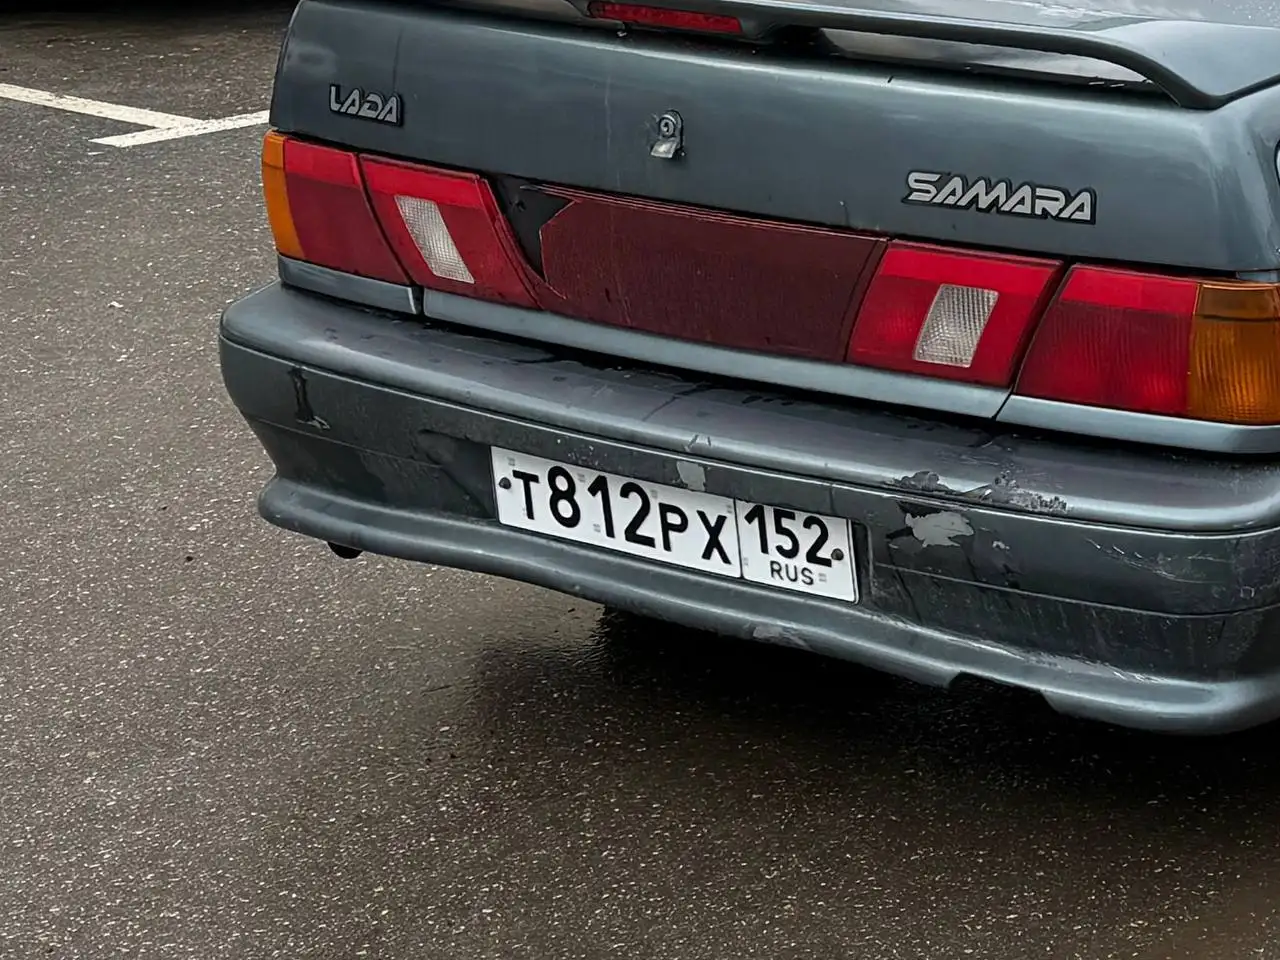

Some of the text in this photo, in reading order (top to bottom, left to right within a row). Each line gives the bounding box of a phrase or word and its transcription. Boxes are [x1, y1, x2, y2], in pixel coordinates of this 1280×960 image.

[329, 84, 400, 124] LADA
[907, 171, 1092, 221] SAMARA
[743, 504, 833, 568] 152
[769, 560, 815, 587] RUS
